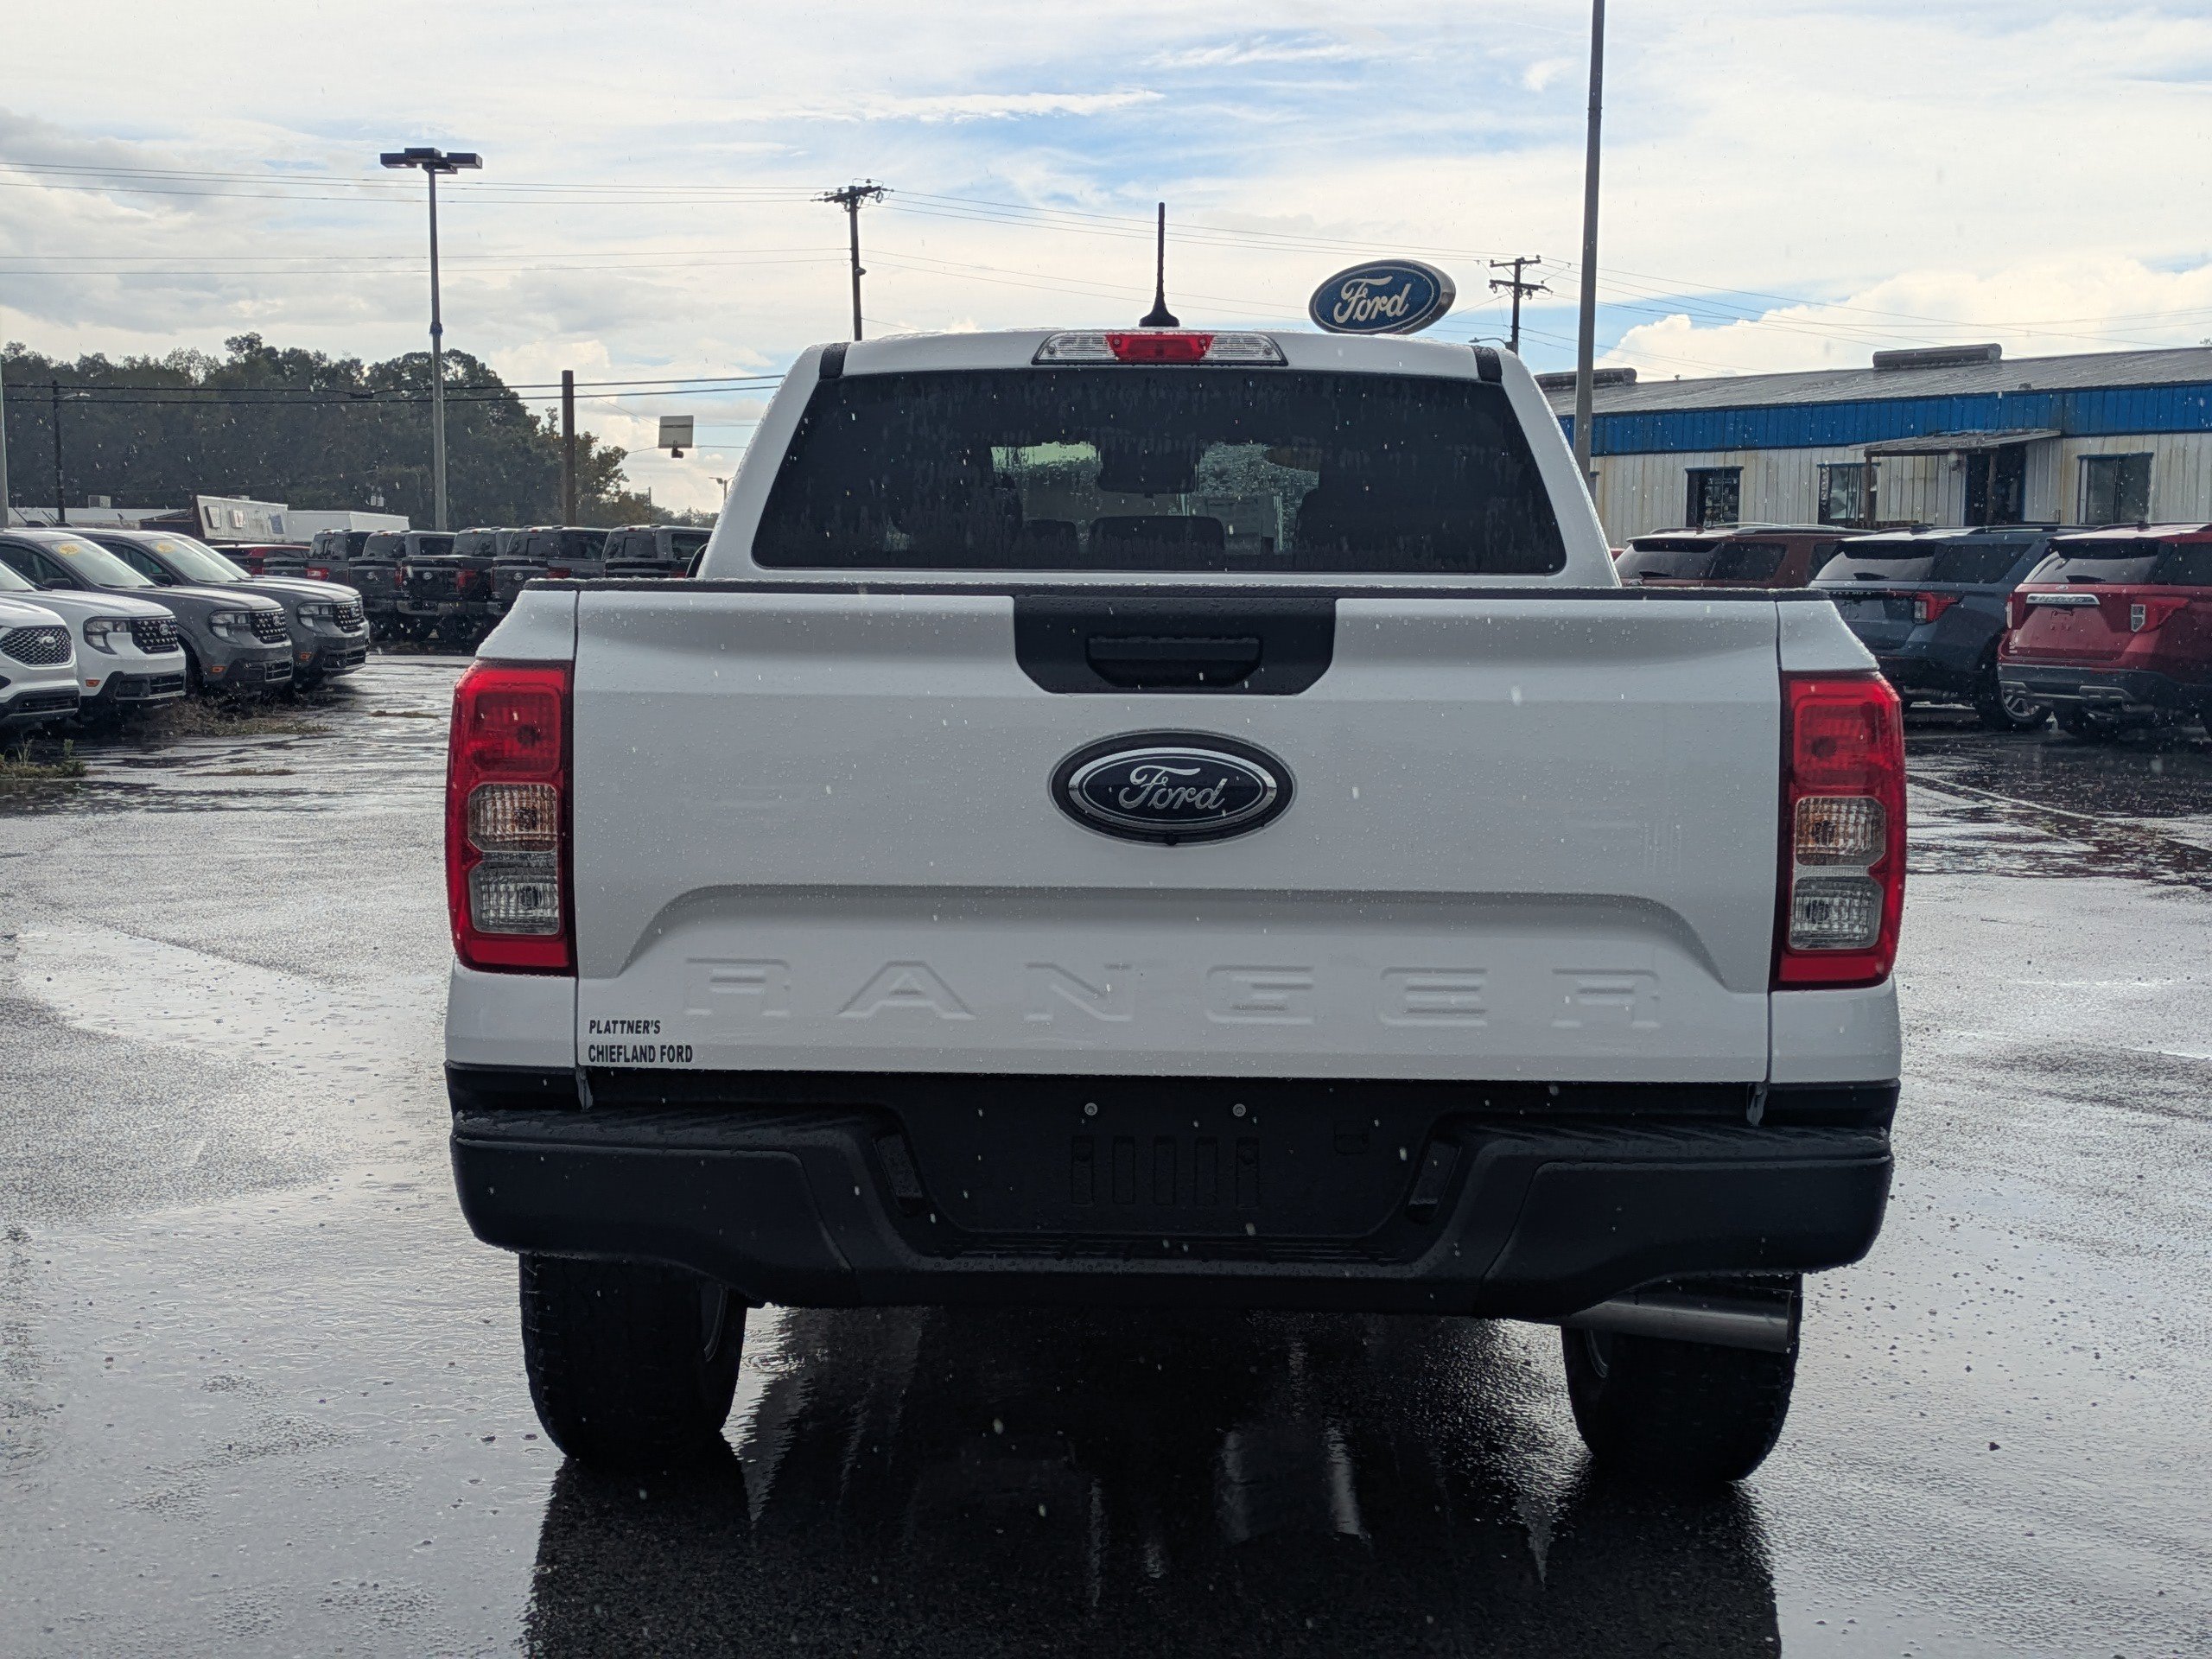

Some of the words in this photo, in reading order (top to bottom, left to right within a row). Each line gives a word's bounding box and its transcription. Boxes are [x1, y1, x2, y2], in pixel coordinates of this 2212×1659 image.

[1333, 275, 1412, 324] Ford
[1118, 765, 1228, 810] Ford
[685, 957, 1660, 1028] RANGER
[588, 1020, 661, 1034] PLATTNER'S
[588, 1044, 656, 1063] CHIEFLAND
[660, 1045, 693, 1063] FORD
